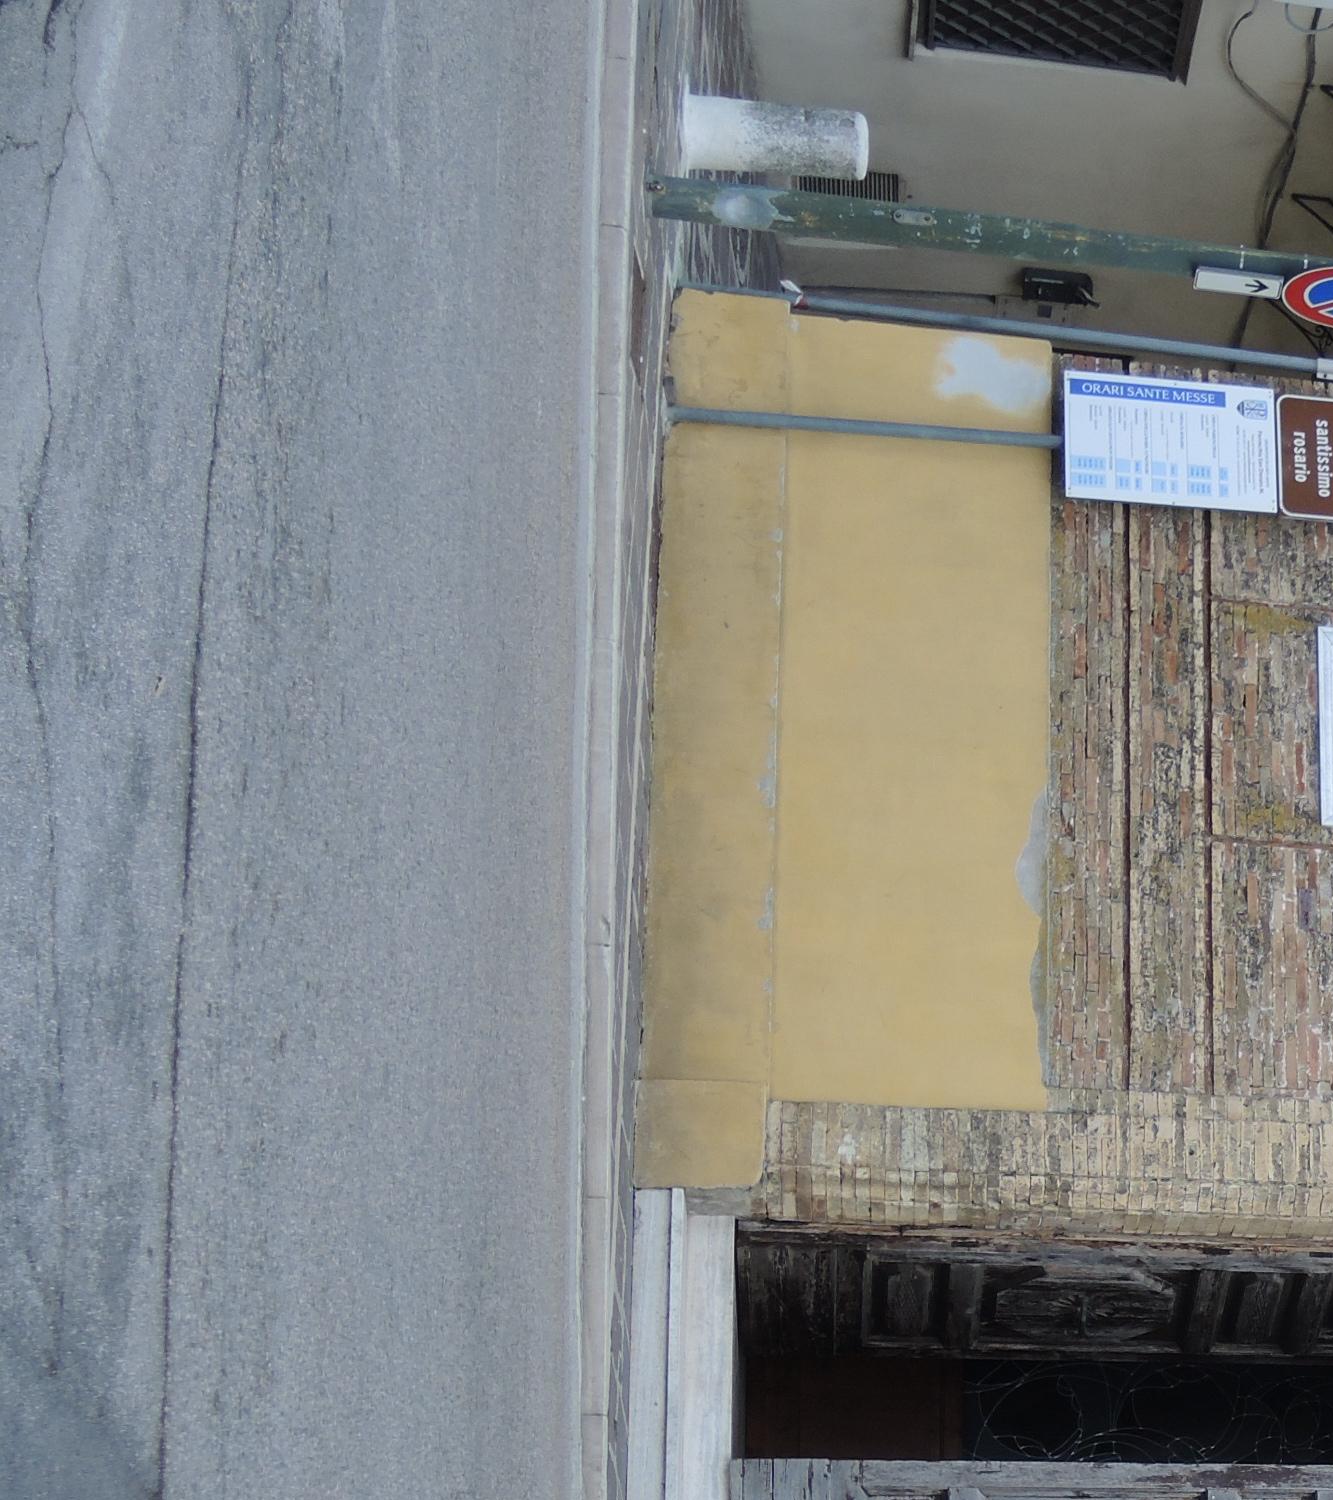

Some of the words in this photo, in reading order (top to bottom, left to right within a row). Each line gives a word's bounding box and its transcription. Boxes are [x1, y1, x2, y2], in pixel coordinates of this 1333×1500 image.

[1082, 382, 1124, 396] ORARI
[1127, 386, 1170, 400] SANTE
[1172, 391, 1216, 404] MESSE
[1293, 431, 1310, 483] rosario
[1316, 419, 1333, 497] santissimo
